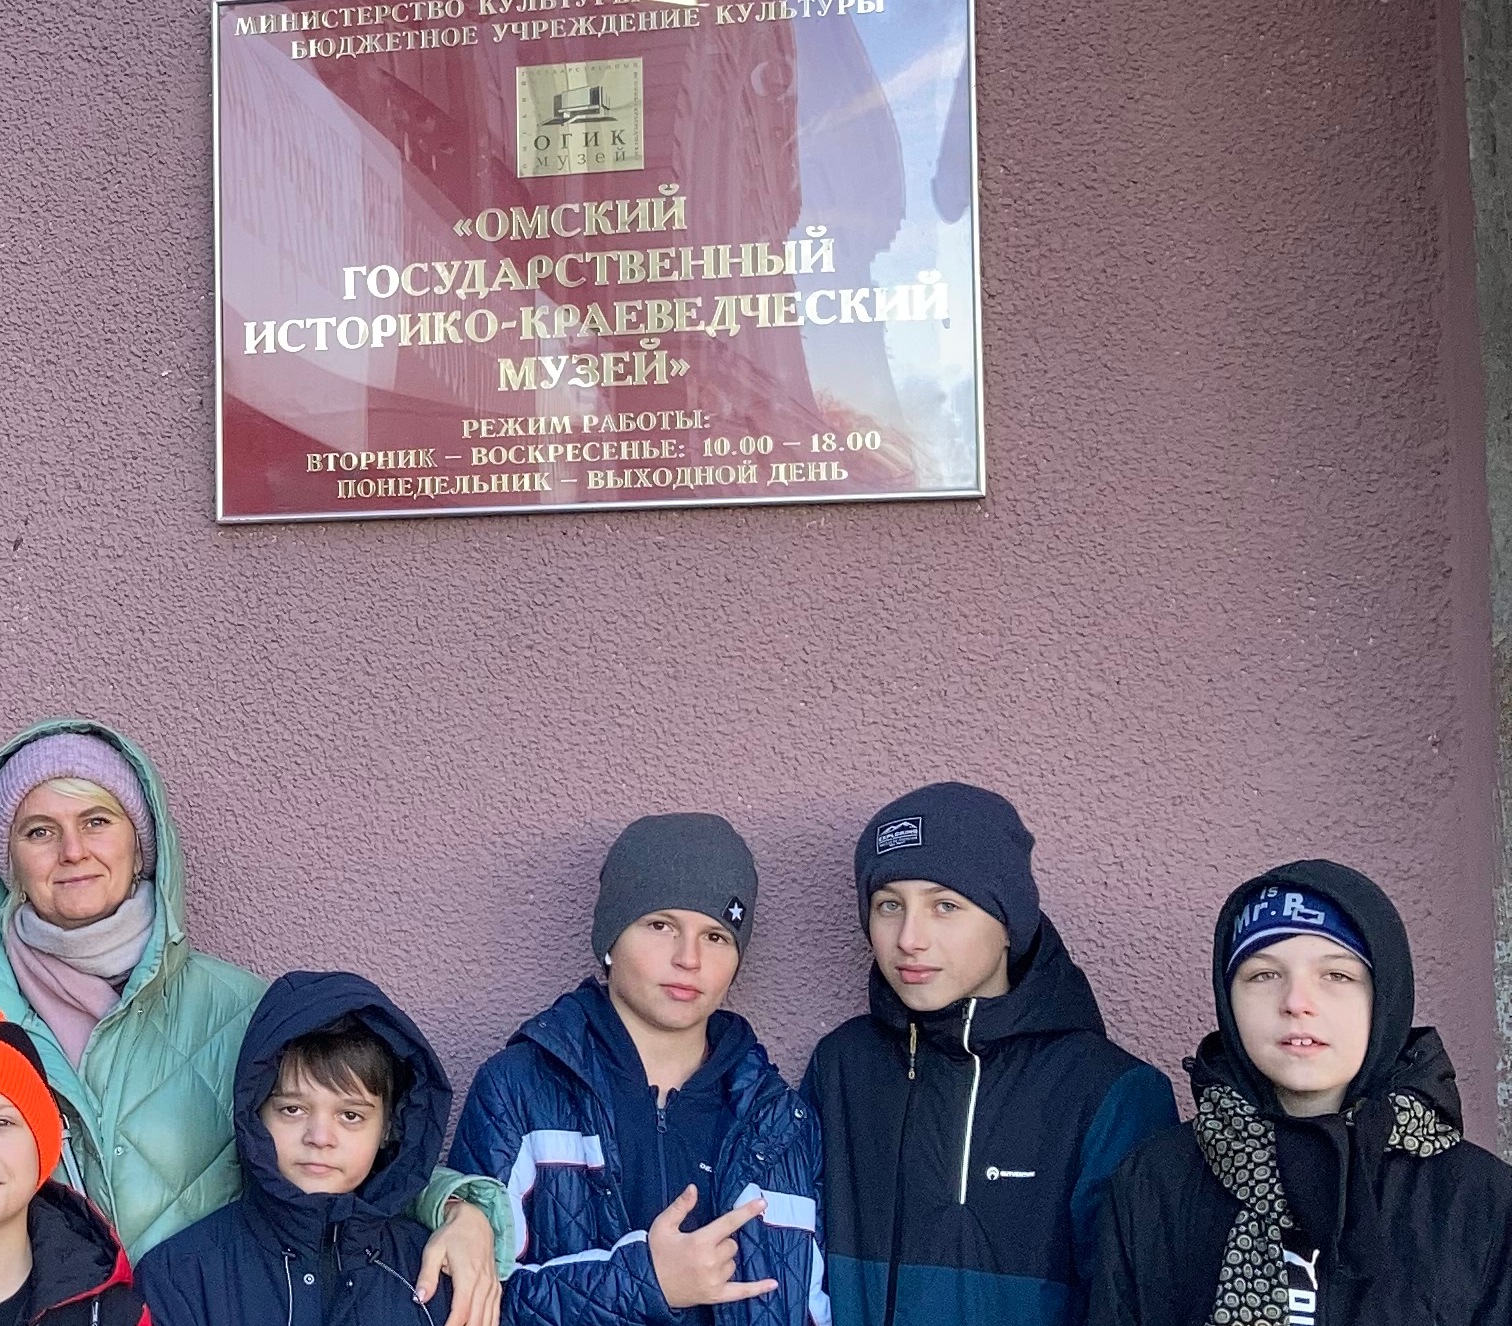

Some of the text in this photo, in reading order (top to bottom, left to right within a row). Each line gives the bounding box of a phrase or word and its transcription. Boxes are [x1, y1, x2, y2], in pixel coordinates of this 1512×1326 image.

[234, 0, 640, 36] МИНИСТЕРСТВО КУЛЬ
[291, 0, 885, 60] БЮДЖЕТНОЕ УЧРЕЖДЕНИЕ КУЛЬТУРЫ
[533, 129, 626, 151] ОГИК
[536, 146, 626, 171] музей
[453, 183, 687, 242] «ОМСКИЙ
[342, 225, 835, 300] ГОСУДАРСТВЕННЫЙ
[243, 270, 950, 354] ИСТОРИКО-КРАЕВЕДЧЕСКИЙ
[498, 337, 690, 392] МУЗЕЙ»
[462, 409, 711, 439] РЕЖИМ РАБОТЫ:
[306, 448, 438, 472] ВТОРНИК
[471, 439, 685, 466] ВОСКРЕСЕНЬЕ:
[702, 435, 773, 457] 10.00
[810, 431, 881, 453] 18.00
[337, 472, 552, 500] ПОНЕДЕЛЬНИК
[587, 459, 758, 489] ВЫХОДНОЙ
[767, 461, 848, 486] ДЕНЬ
